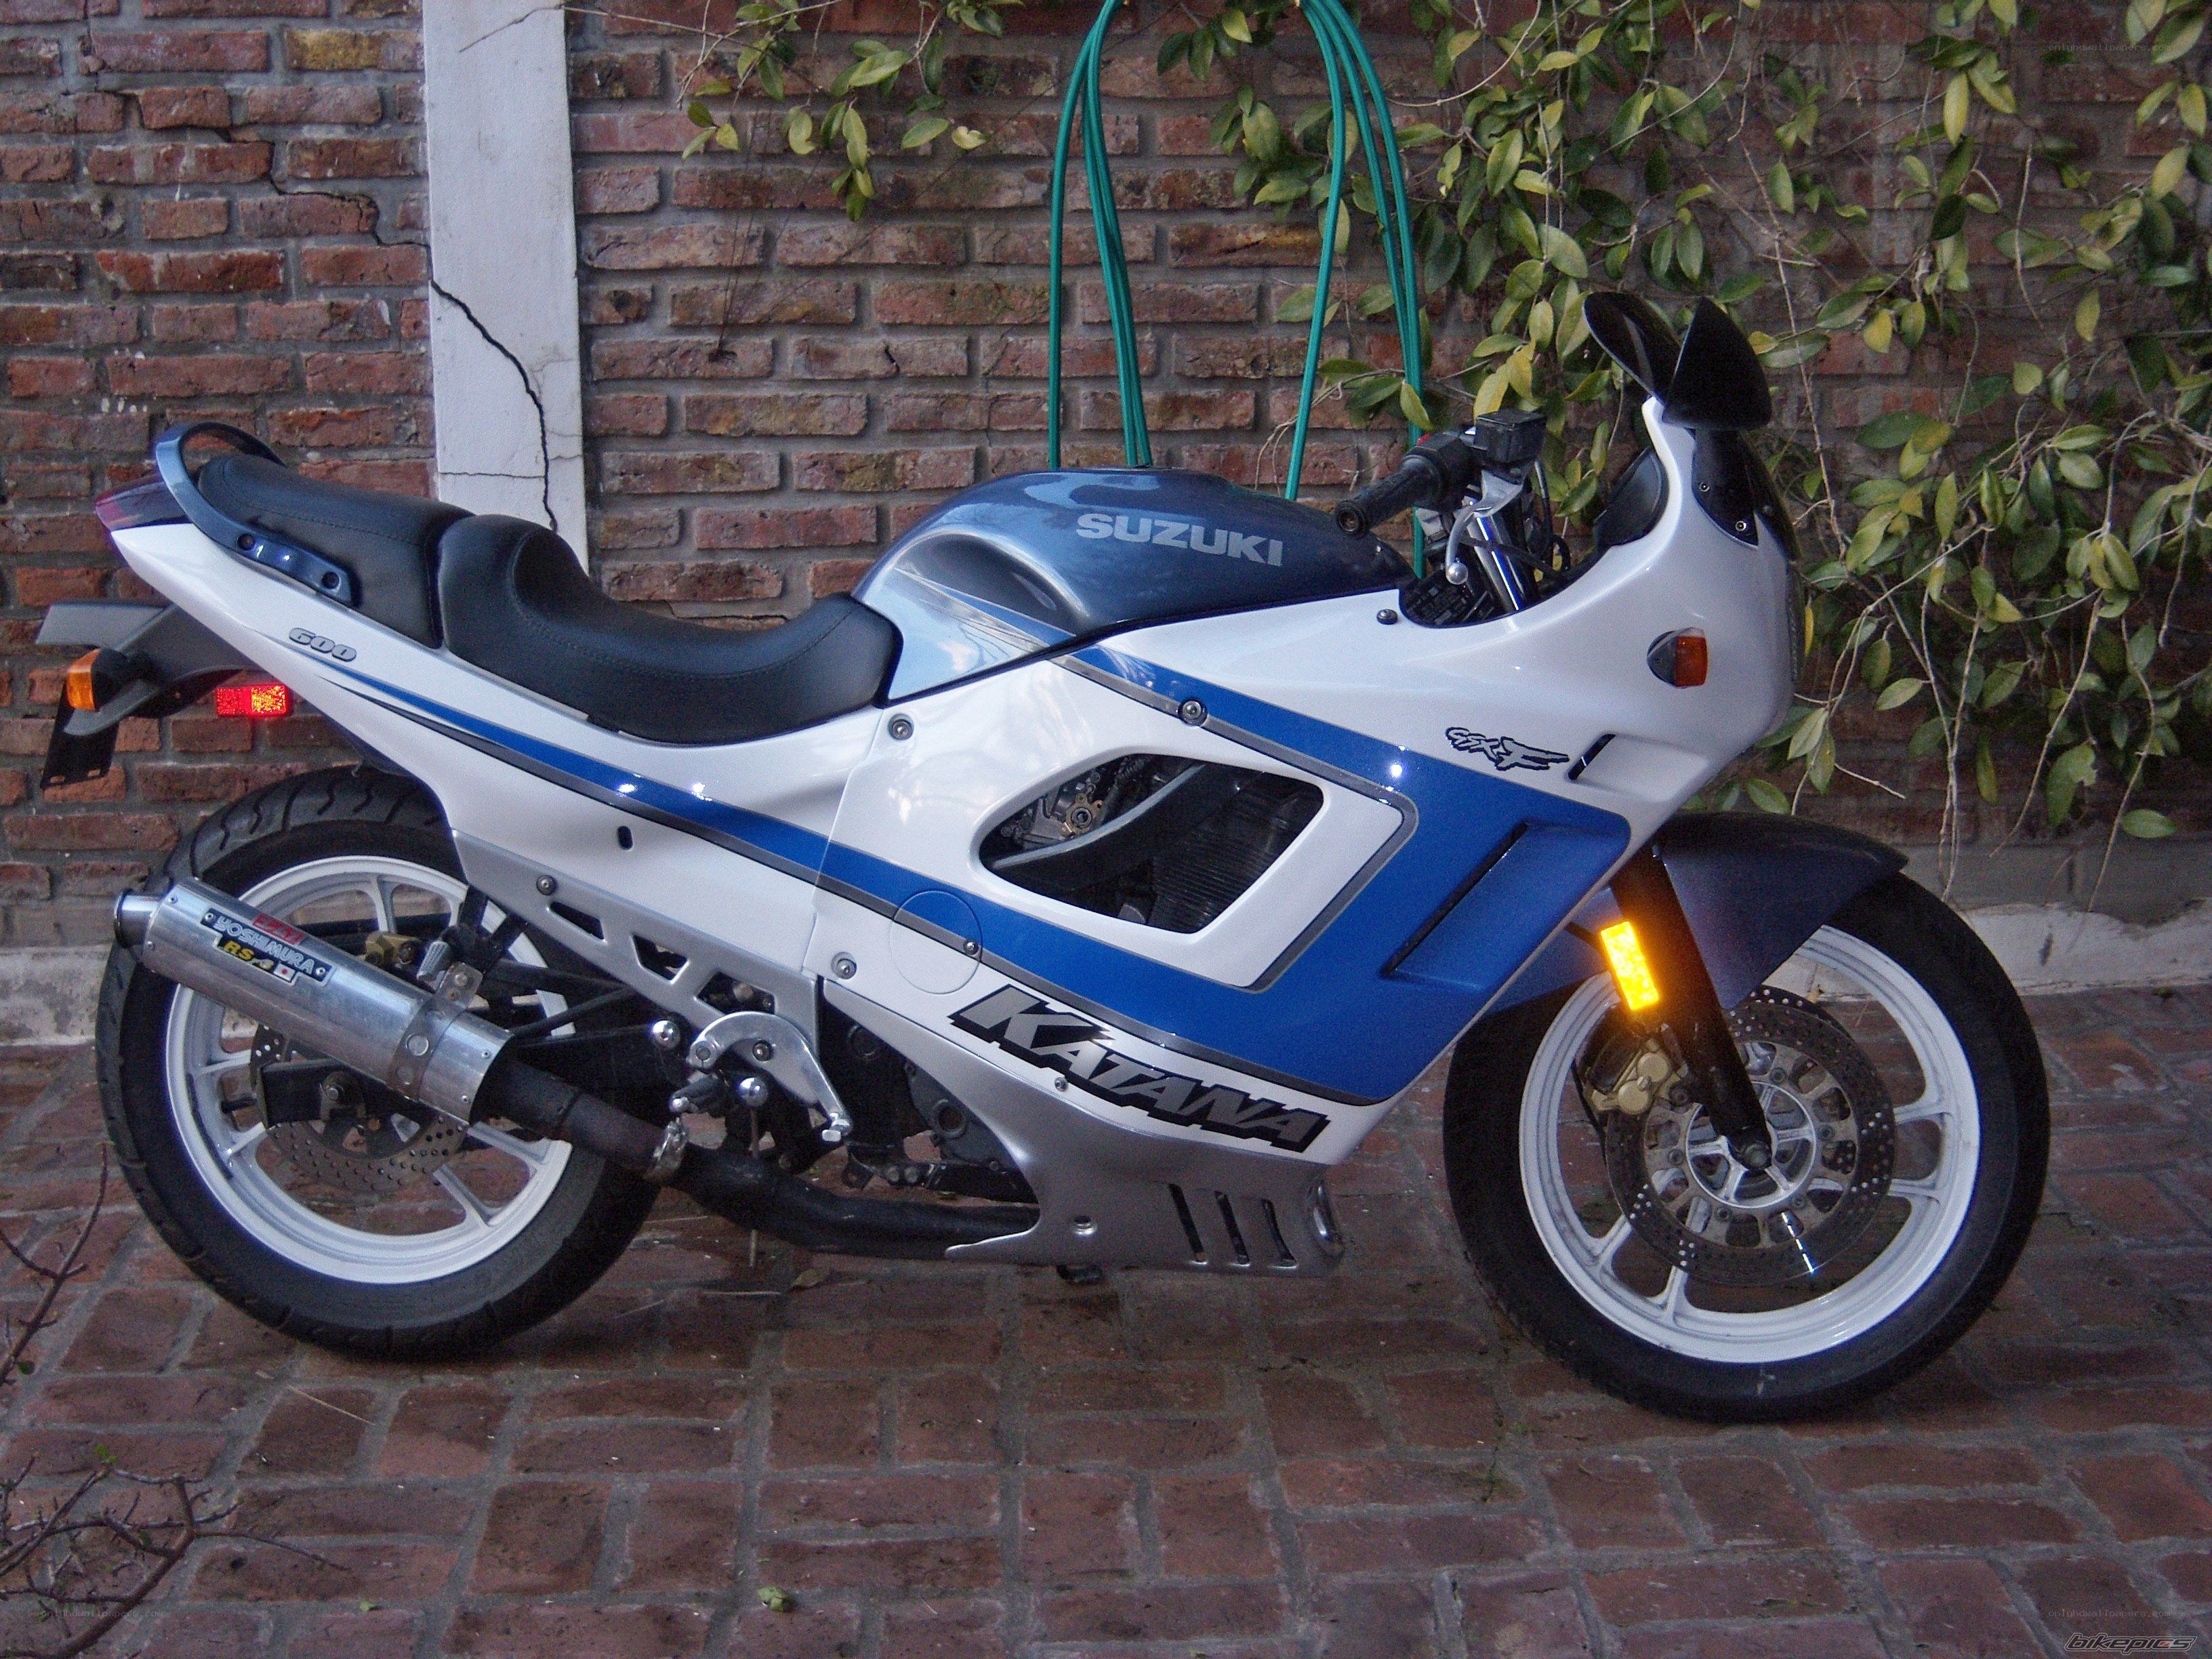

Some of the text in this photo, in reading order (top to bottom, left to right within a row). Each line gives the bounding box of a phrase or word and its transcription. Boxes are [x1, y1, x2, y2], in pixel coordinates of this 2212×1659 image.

[1076, 513, 1284, 567] SUZUKI
[289, 628, 357, 662] 600
[213, 915, 315, 975] YOSHIMURA
[948, 983, 1331, 1153] KATANA
